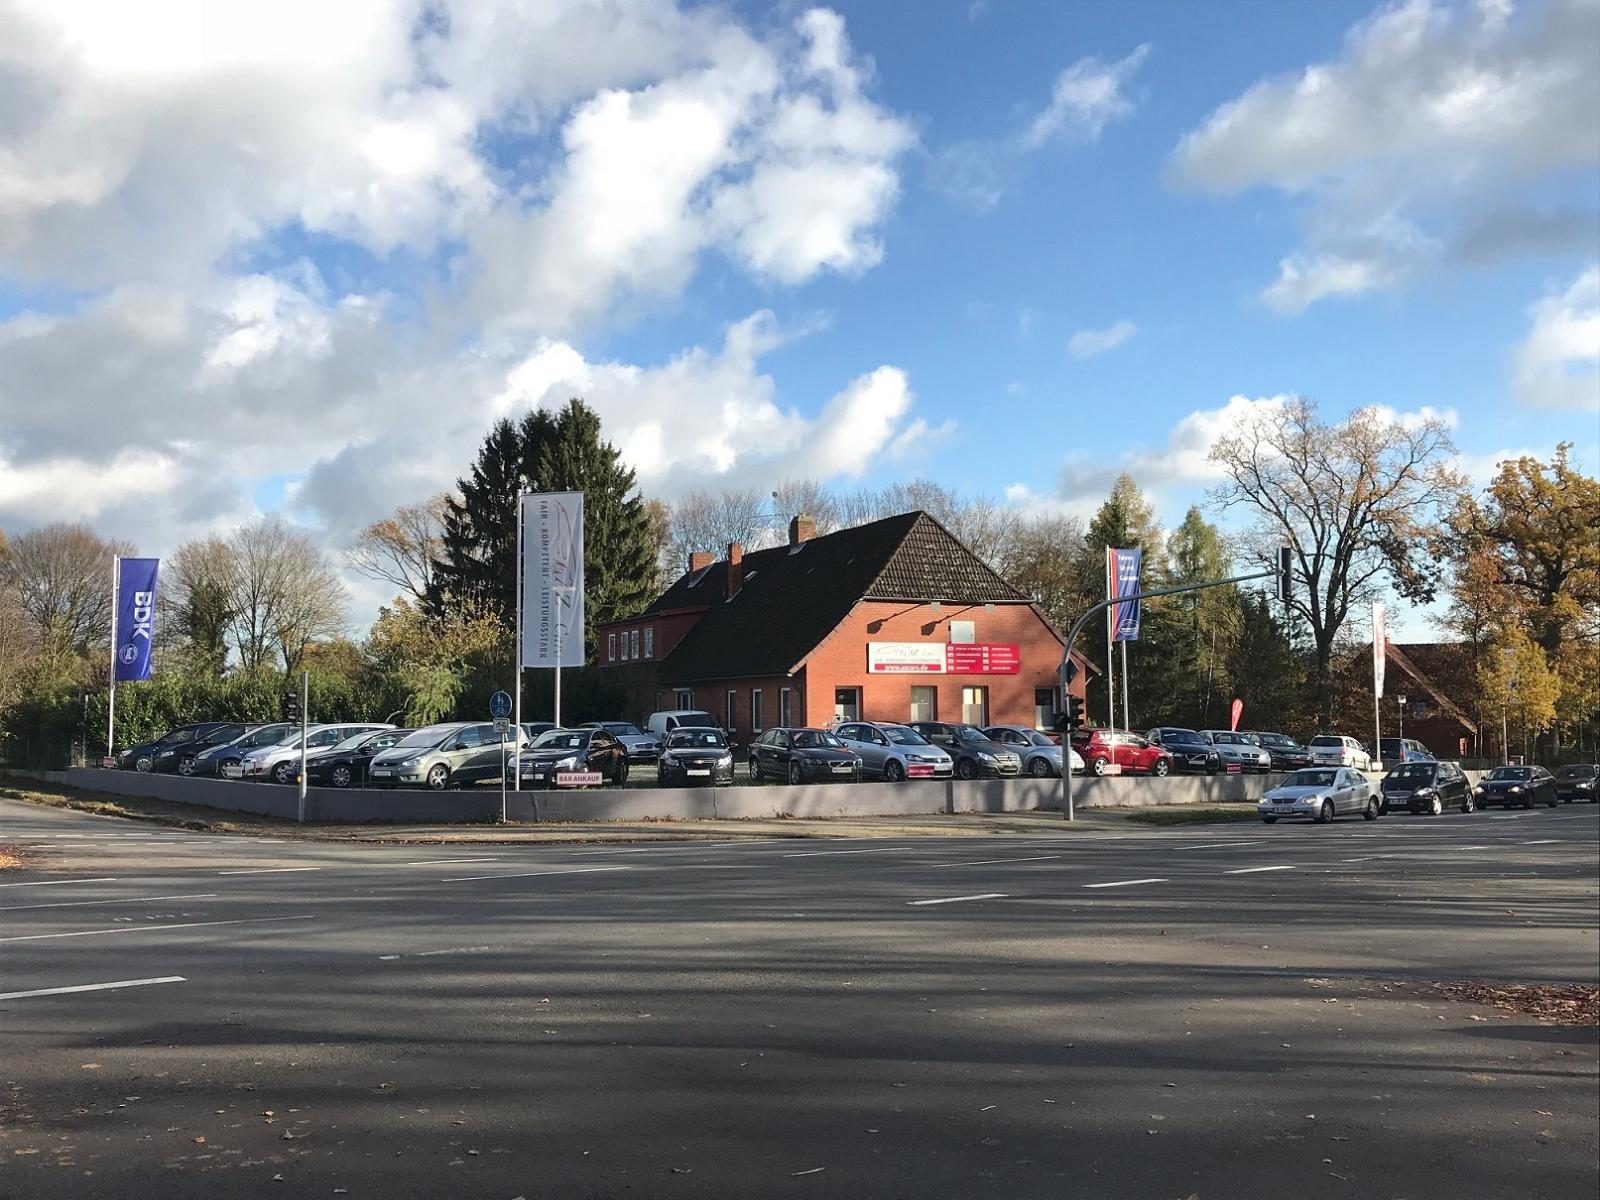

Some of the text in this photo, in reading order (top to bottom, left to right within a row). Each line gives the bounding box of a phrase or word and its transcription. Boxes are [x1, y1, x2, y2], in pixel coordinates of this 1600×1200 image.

[541, 528, 550, 577] KOMPETENT
[132, 591, 153, 640] BDK
[539, 586, 550, 659] LEISTUNGSSTARK
